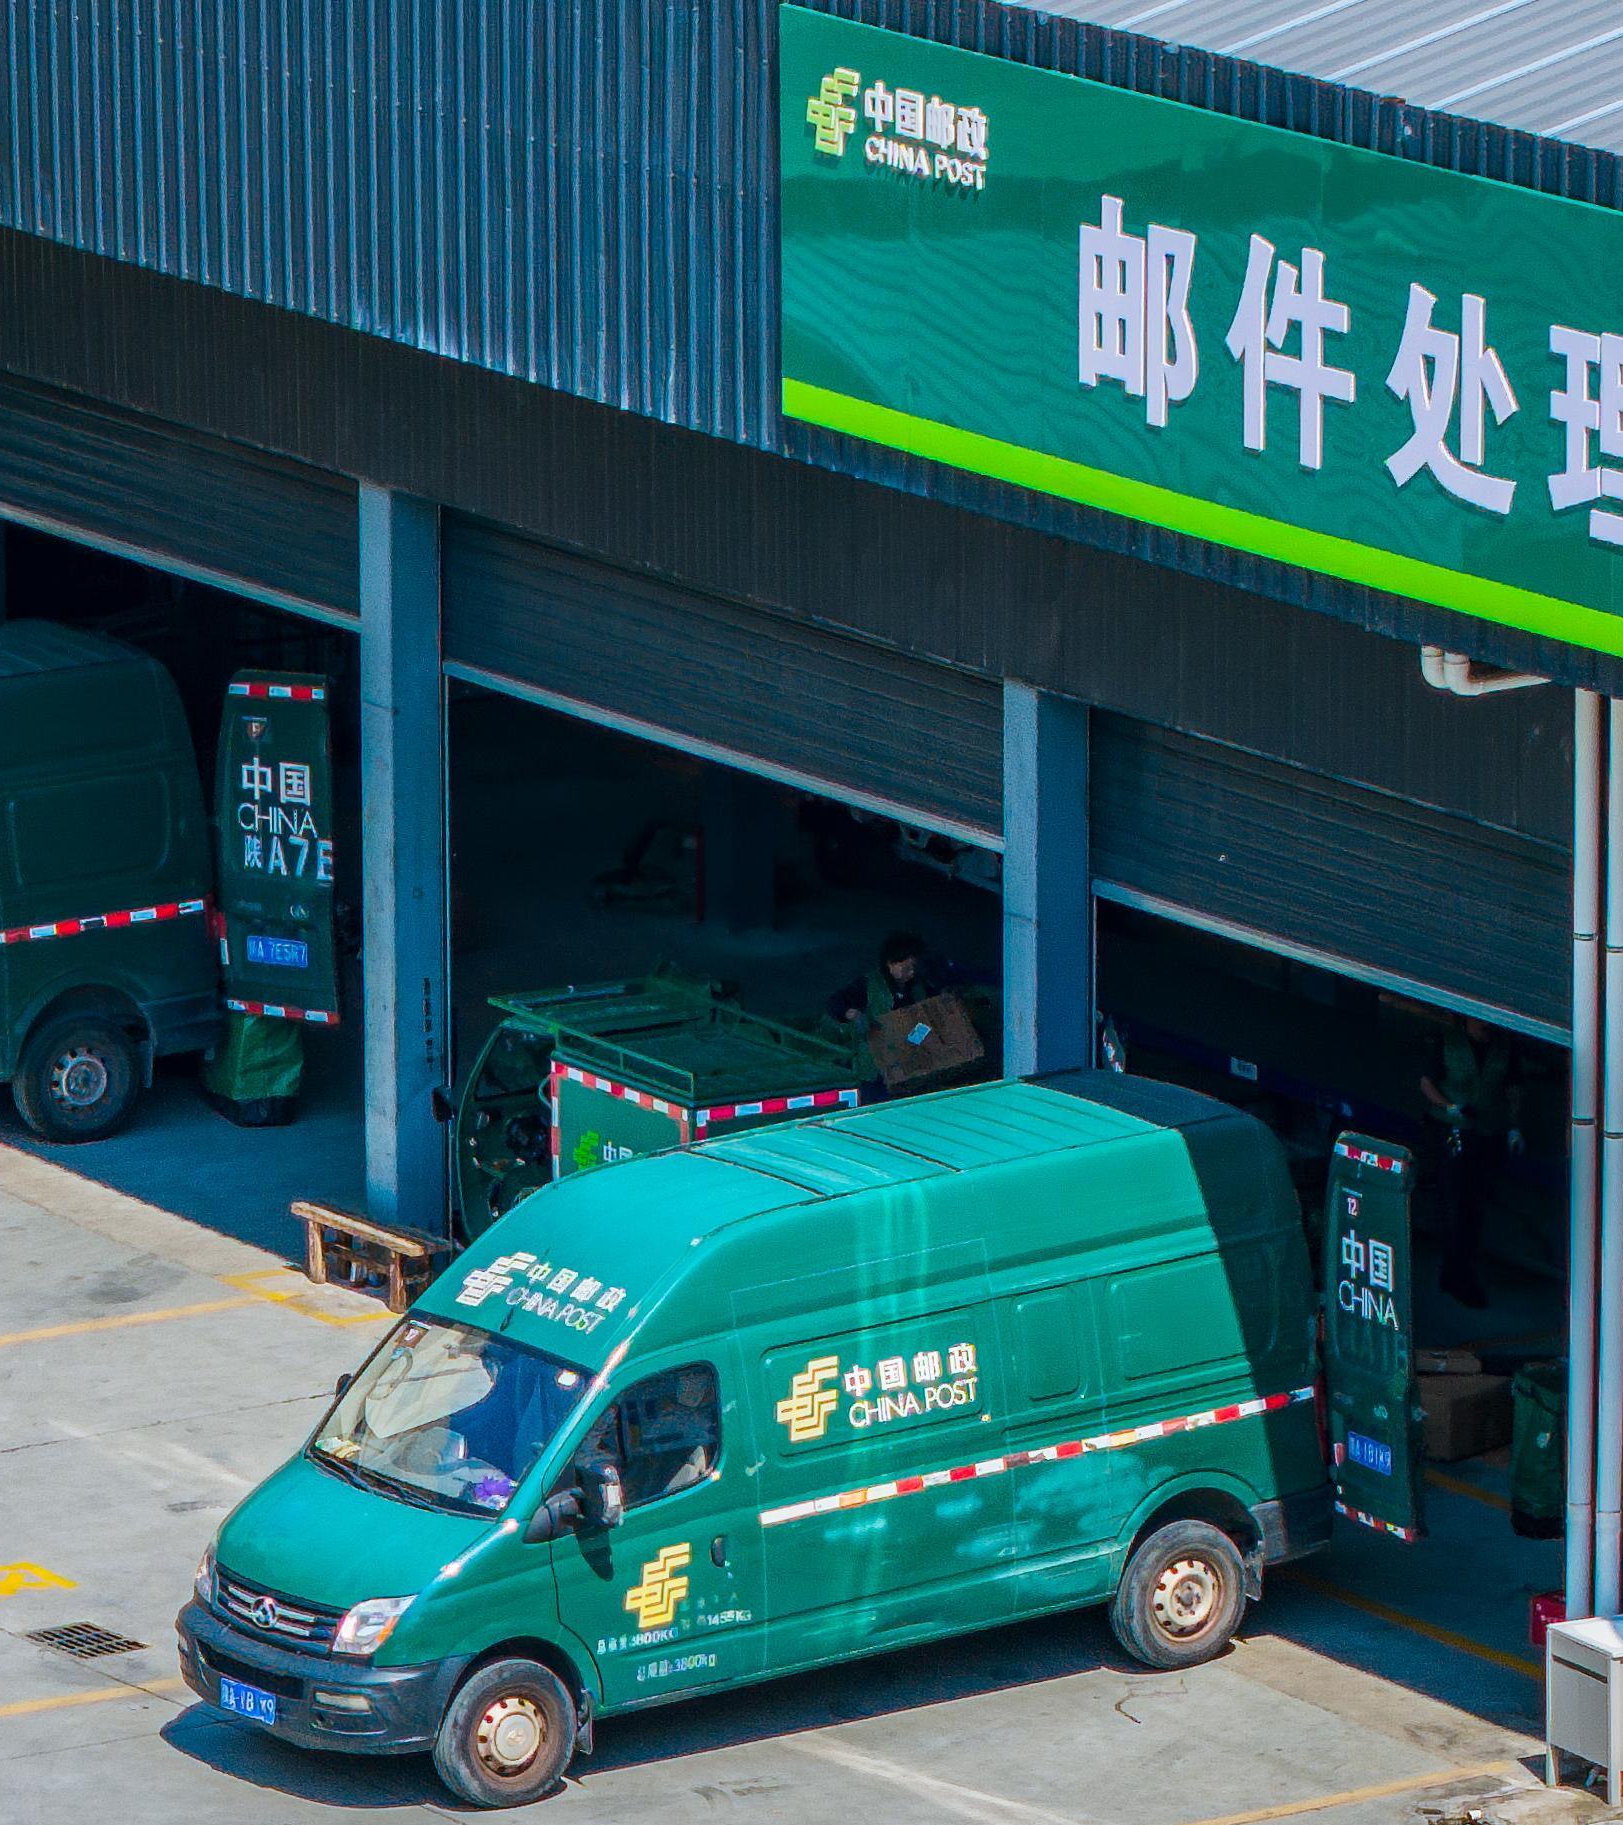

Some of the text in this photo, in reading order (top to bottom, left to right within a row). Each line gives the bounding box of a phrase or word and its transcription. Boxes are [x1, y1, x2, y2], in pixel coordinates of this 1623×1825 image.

[863, 80, 989, 160] 中国邮政
[864, 135, 987, 191] CHINA POST
[241, 757, 311, 806] 中国
[237, 803, 318, 838] CHINA
[1341, 1229, 1393, 1292] 中国
[526, 1262, 627, 1313] 中国邮政
[1339, 1280, 1399, 1331] CHINA
[555, 1303, 606, 1335] POST
[844, 1343, 978, 1397] 中国邮政
[849, 1376, 978, 1427] CHINA POST
